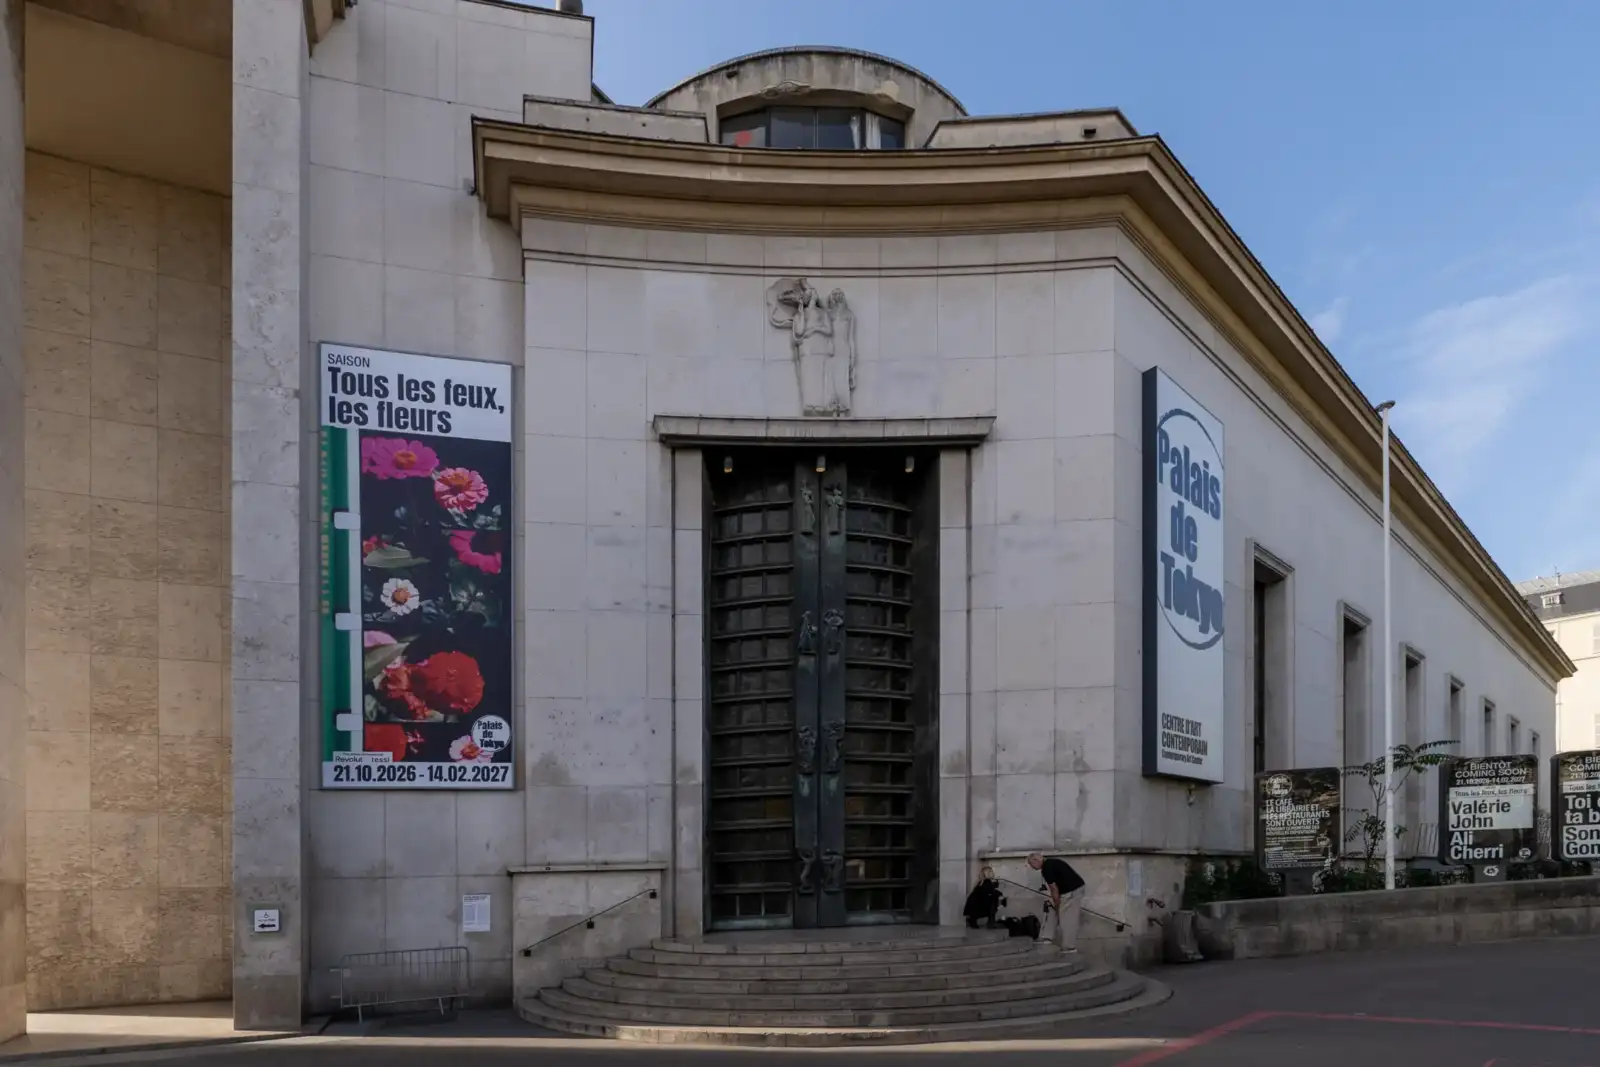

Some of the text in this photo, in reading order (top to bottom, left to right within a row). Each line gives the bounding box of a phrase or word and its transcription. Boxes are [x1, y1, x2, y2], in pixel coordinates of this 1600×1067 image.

[327, 353, 370, 368] SAISON
[327, 366, 505, 414] Tous les feux,
[328, 396, 452, 434] les fleurs
[1158, 427, 1220, 520] Palais
[1171, 500, 1198, 563] de
[1160, 550, 1223, 634] Tokyo
[477, 720, 503, 730] Palais
[1162, 713, 1184, 734] CENTRE
[482, 730, 493, 738] de
[480, 739, 505, 749] Tokyo
[335, 755, 363, 763] Revolut
[1469, 760, 1512, 771] BIENTÔT
[333, 765, 416, 782] 21.10.2026
[427, 765, 509, 782] 14.02.2027
[1455, 767, 1527, 779] COMING SOON
[1275, 804, 1310, 813] LIBRAIRIE
[1310, 803, 1319, 811] ET
[1451, 799, 1511, 815] Valérie
[1564, 794, 1592, 810] Toi
[1266, 818, 1320, 827] SONT OUVERTS
[1278, 810, 1330, 820] RESTAURANTS
[1451, 815, 1494, 829] John
[1564, 809, 1583, 824] ta
[1450, 830, 1473, 846] Ali
[1450, 843, 1504, 860] Cherri
